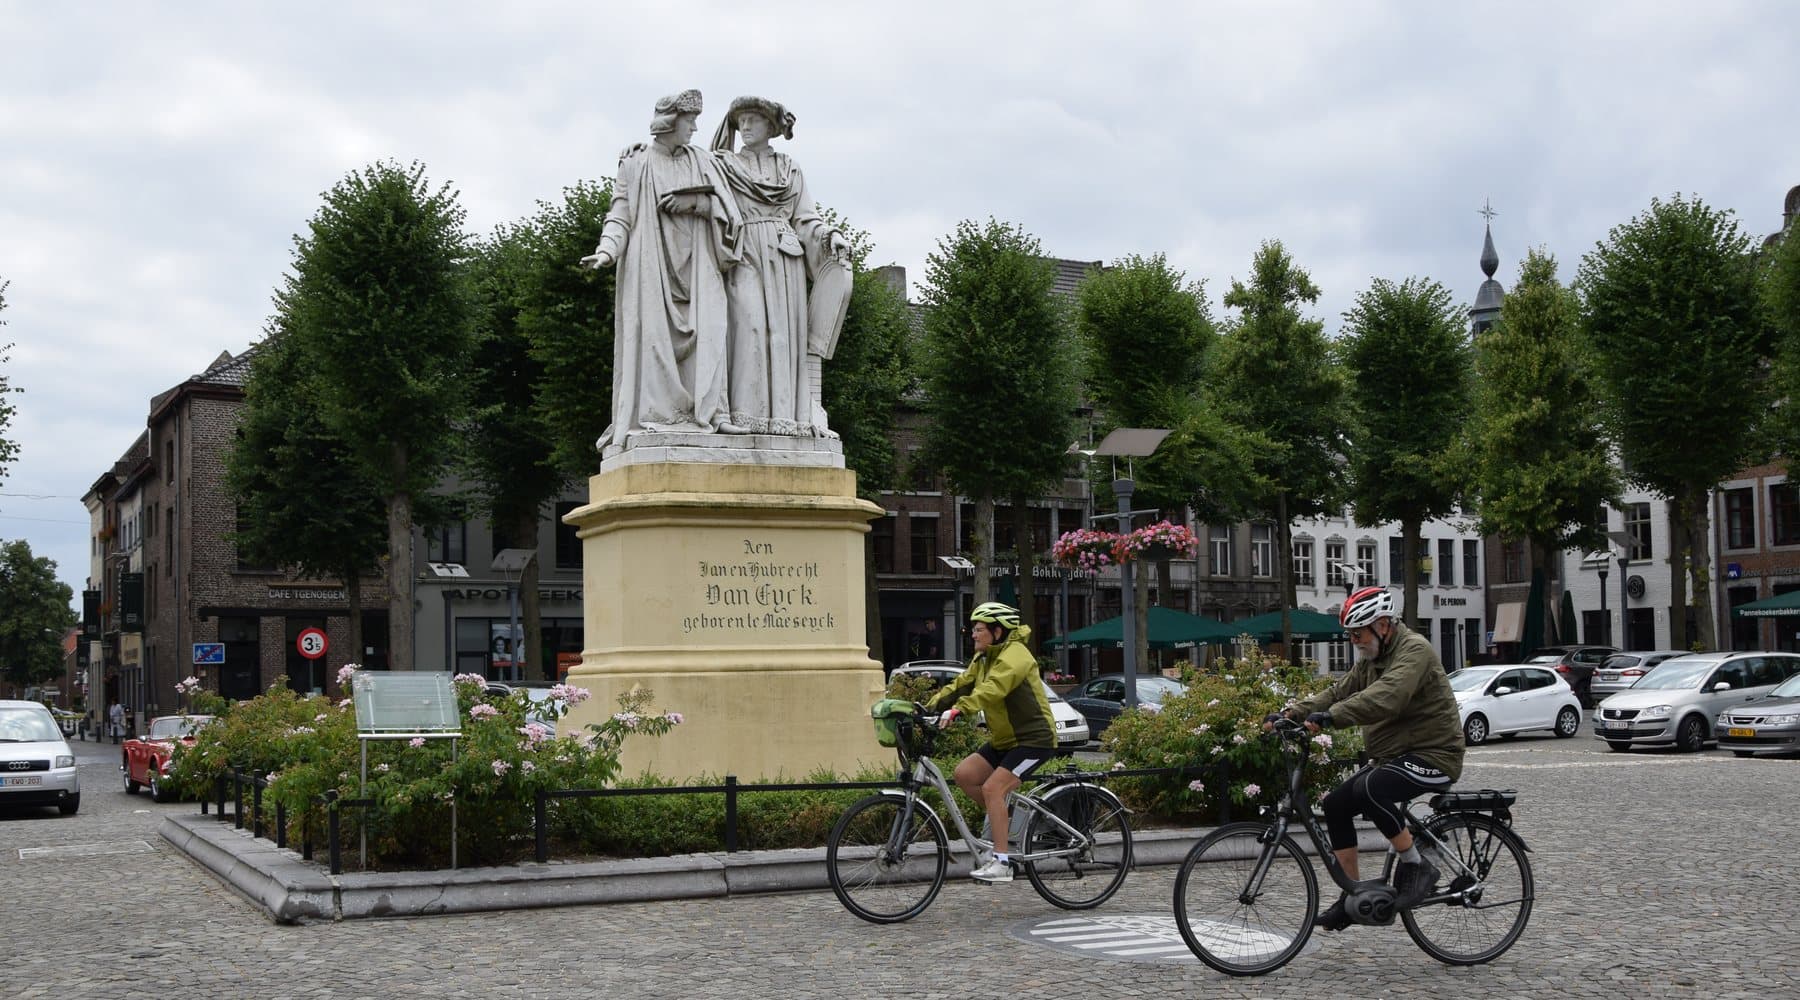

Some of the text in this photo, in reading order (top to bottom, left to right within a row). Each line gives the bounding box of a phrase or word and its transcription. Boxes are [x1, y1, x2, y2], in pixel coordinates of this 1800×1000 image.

[743, 539, 774, 555] Aen
[450, 589, 584, 601] APOTEEK
[706, 583, 751, 606] Van
[1440, 598, 1447, 606] DE
[683, 612, 745, 634] geboren
